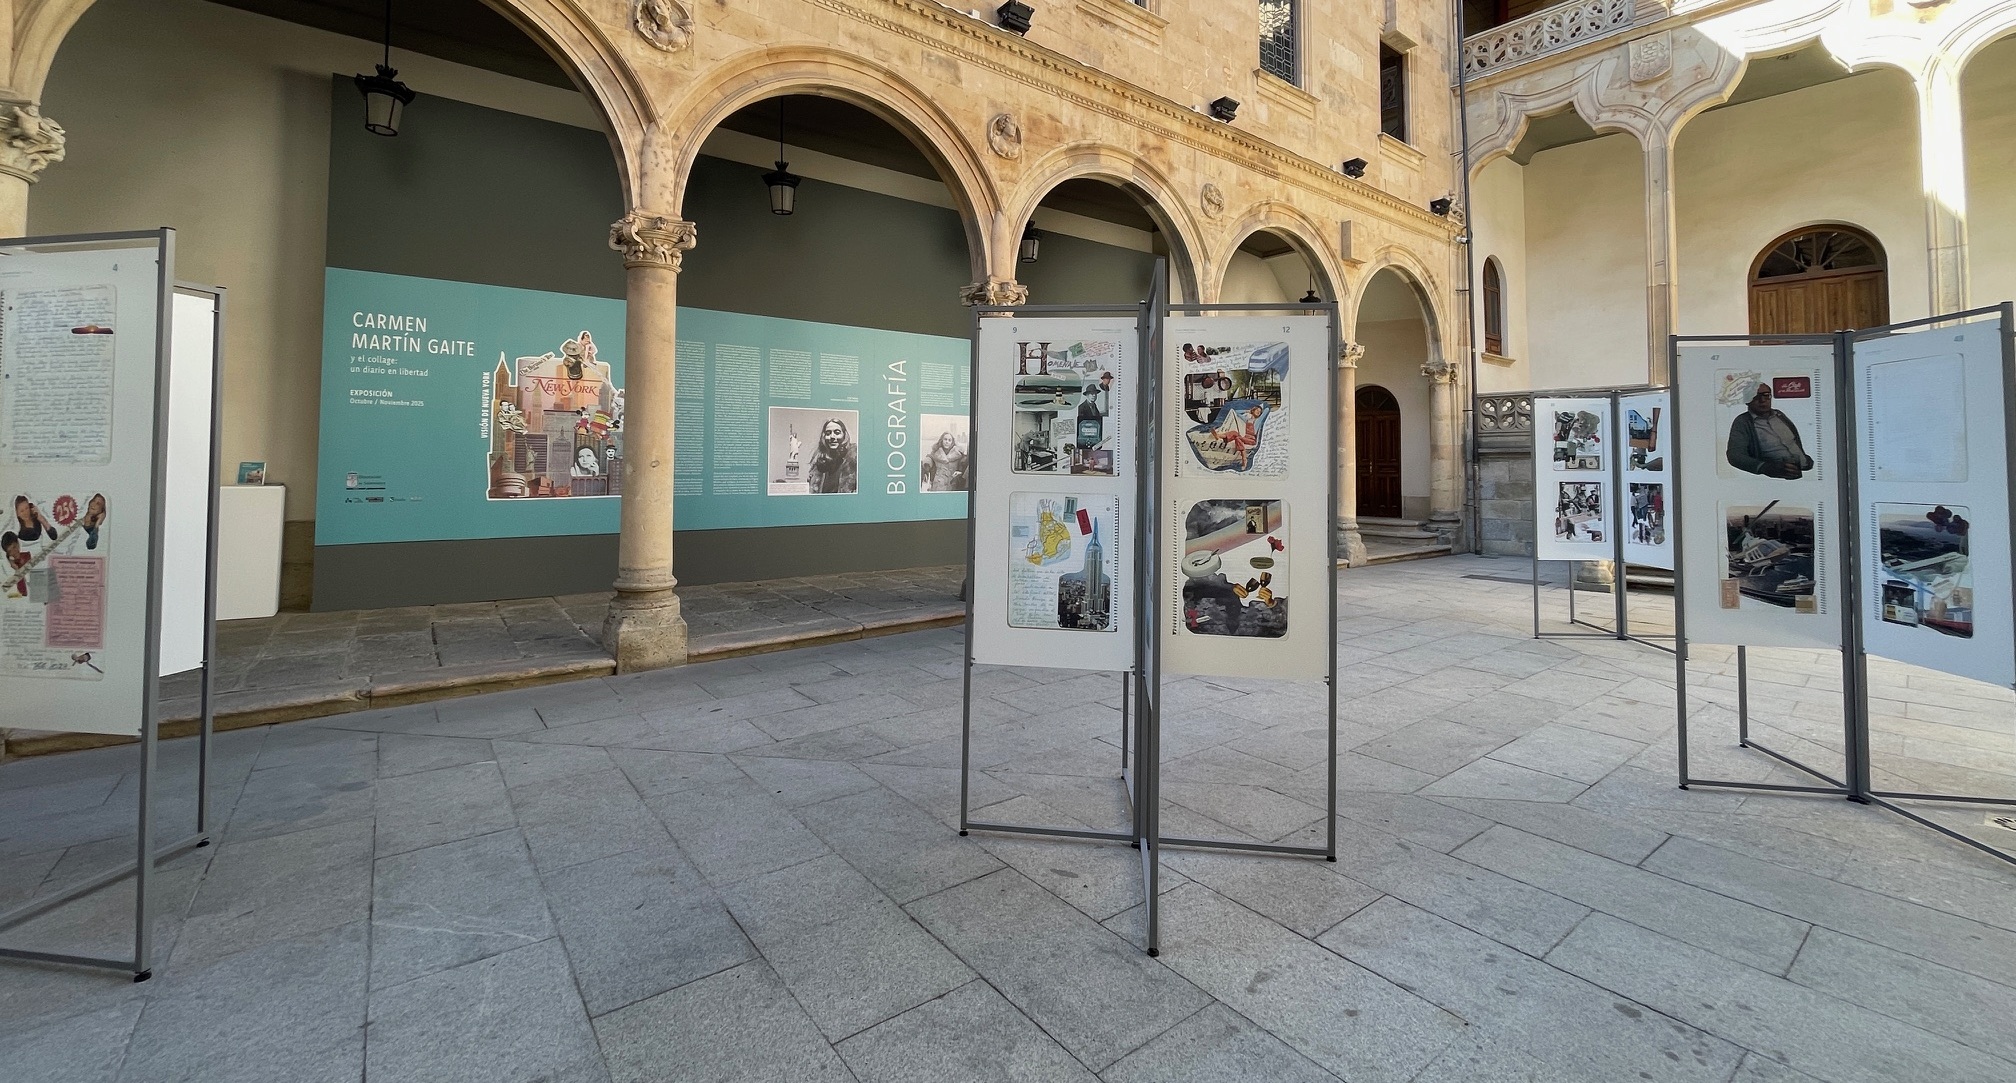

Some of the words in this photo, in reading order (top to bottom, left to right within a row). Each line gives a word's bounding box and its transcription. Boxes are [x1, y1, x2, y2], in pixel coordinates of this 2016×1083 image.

[352, 311, 427, 333] CARMEN
[352, 332, 421, 353] MARTÍN
[427, 338, 475, 357] GAITE
[350, 355, 356, 364] y
[357, 355, 365, 363] el
[367, 355, 399, 366] collage:
[362, 365, 386, 374] diario
[399, 367, 429, 377] libertad
[482, 371, 491, 388] YORK
[349, 388, 393, 398] EXPOSICIÓN
[349, 397, 373, 405] Octubre
[379, 398, 410, 406] Noviembre
[481, 389, 490, 408] NUEVA
[481, 409, 489, 417] DE
[479, 417, 489, 439] VISIÓN
[882, 360, 907, 495] BIOGRAFÍA
